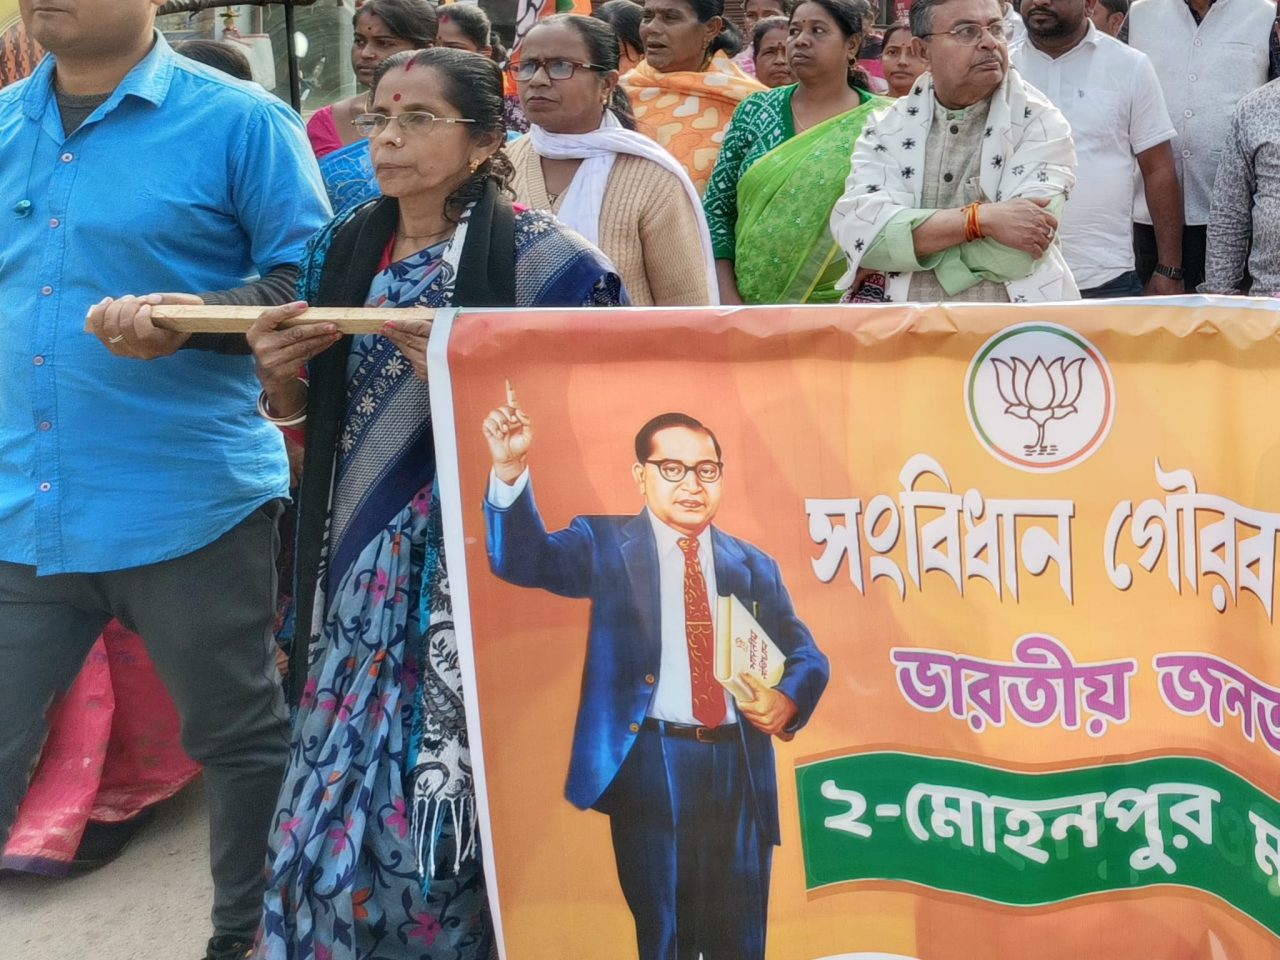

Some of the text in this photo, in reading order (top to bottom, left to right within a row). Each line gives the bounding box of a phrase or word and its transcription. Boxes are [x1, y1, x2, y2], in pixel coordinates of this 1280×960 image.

[804, 453, 1076, 602] সংবিধান
[892, 634, 1136, 736] ভারতীয়
[819, 779, 1221, 875] ২-মোহনপুর
